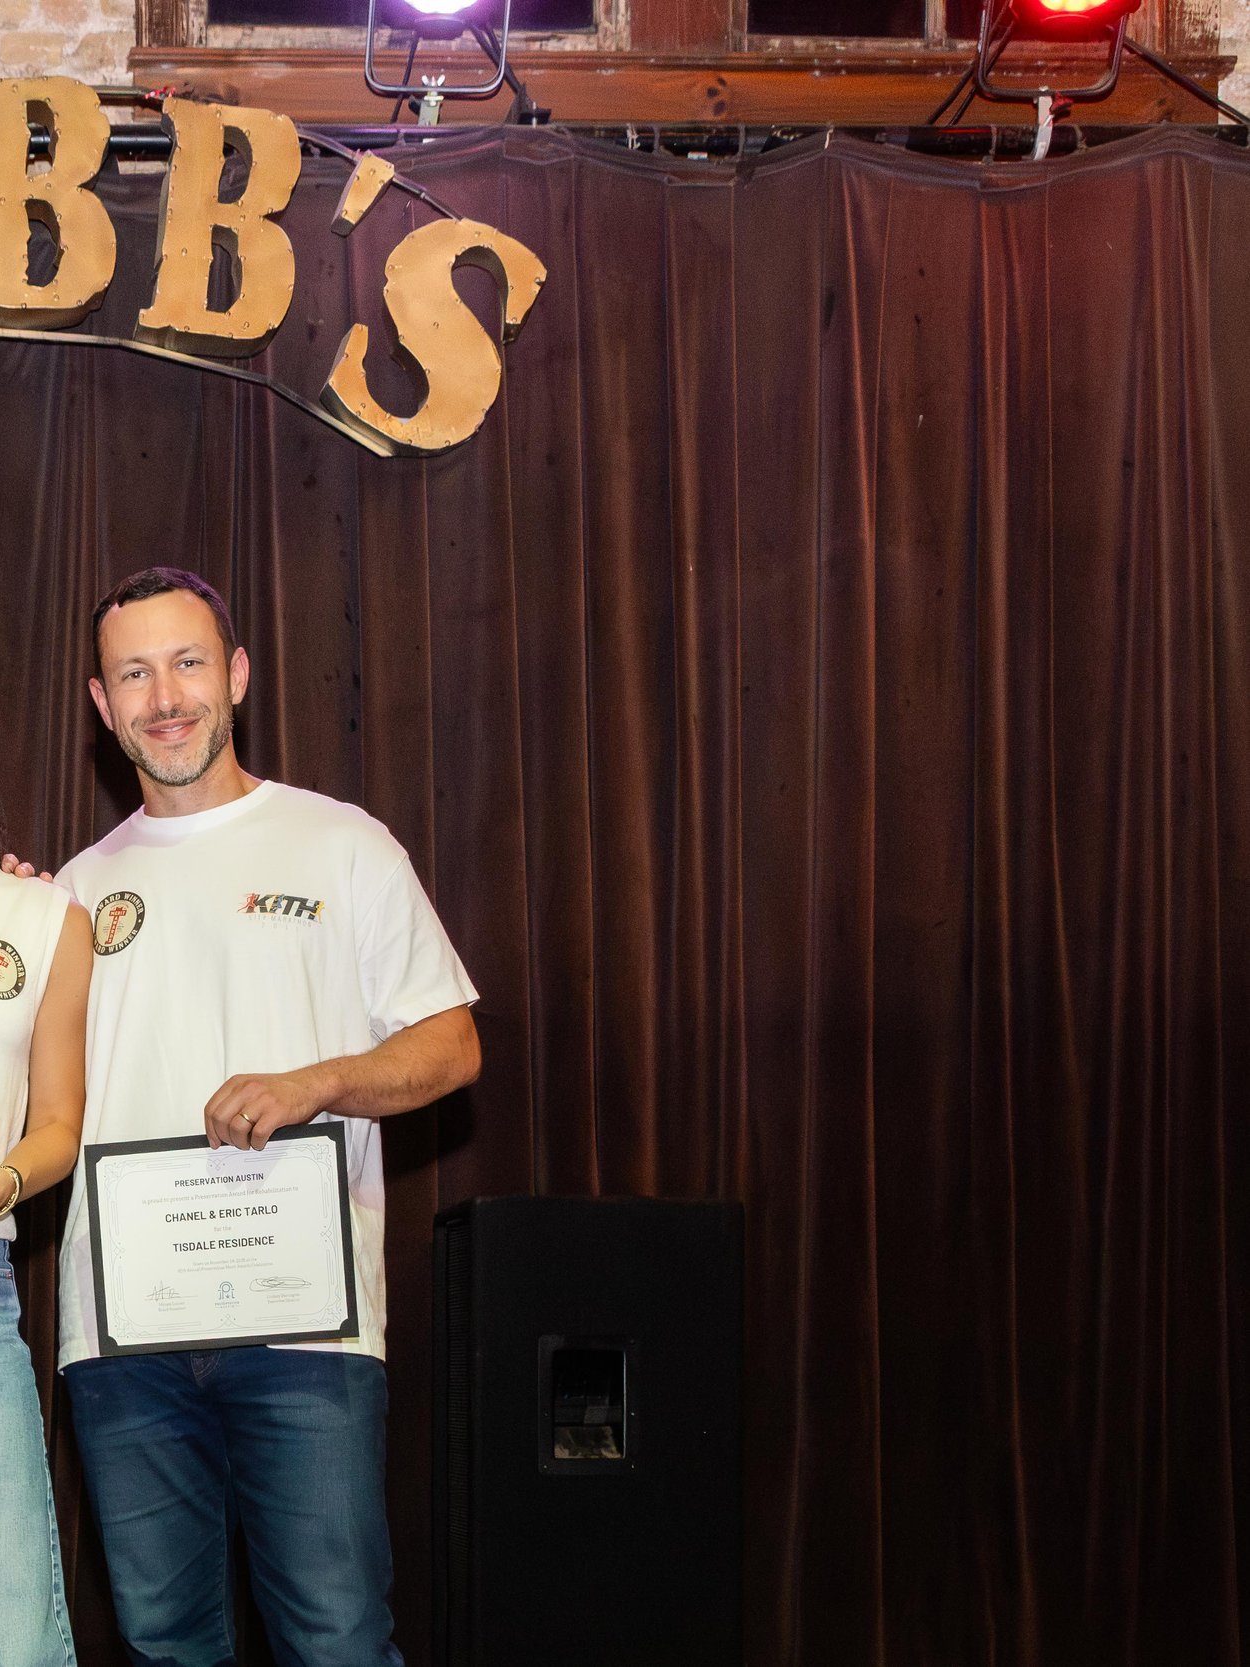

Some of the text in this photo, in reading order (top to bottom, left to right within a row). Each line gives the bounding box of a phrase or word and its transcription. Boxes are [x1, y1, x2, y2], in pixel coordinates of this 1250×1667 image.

[246, 894, 320, 920] KITH
[5, 946, 25, 978] WINNER
[174, 1172, 264, 1188] PRESERVATION AUSTIN
[165, 1204, 278, 1223] CHANEL & ERIC TARLO
[173, 1235, 275, 1252] TISDALE RESIDENCE
